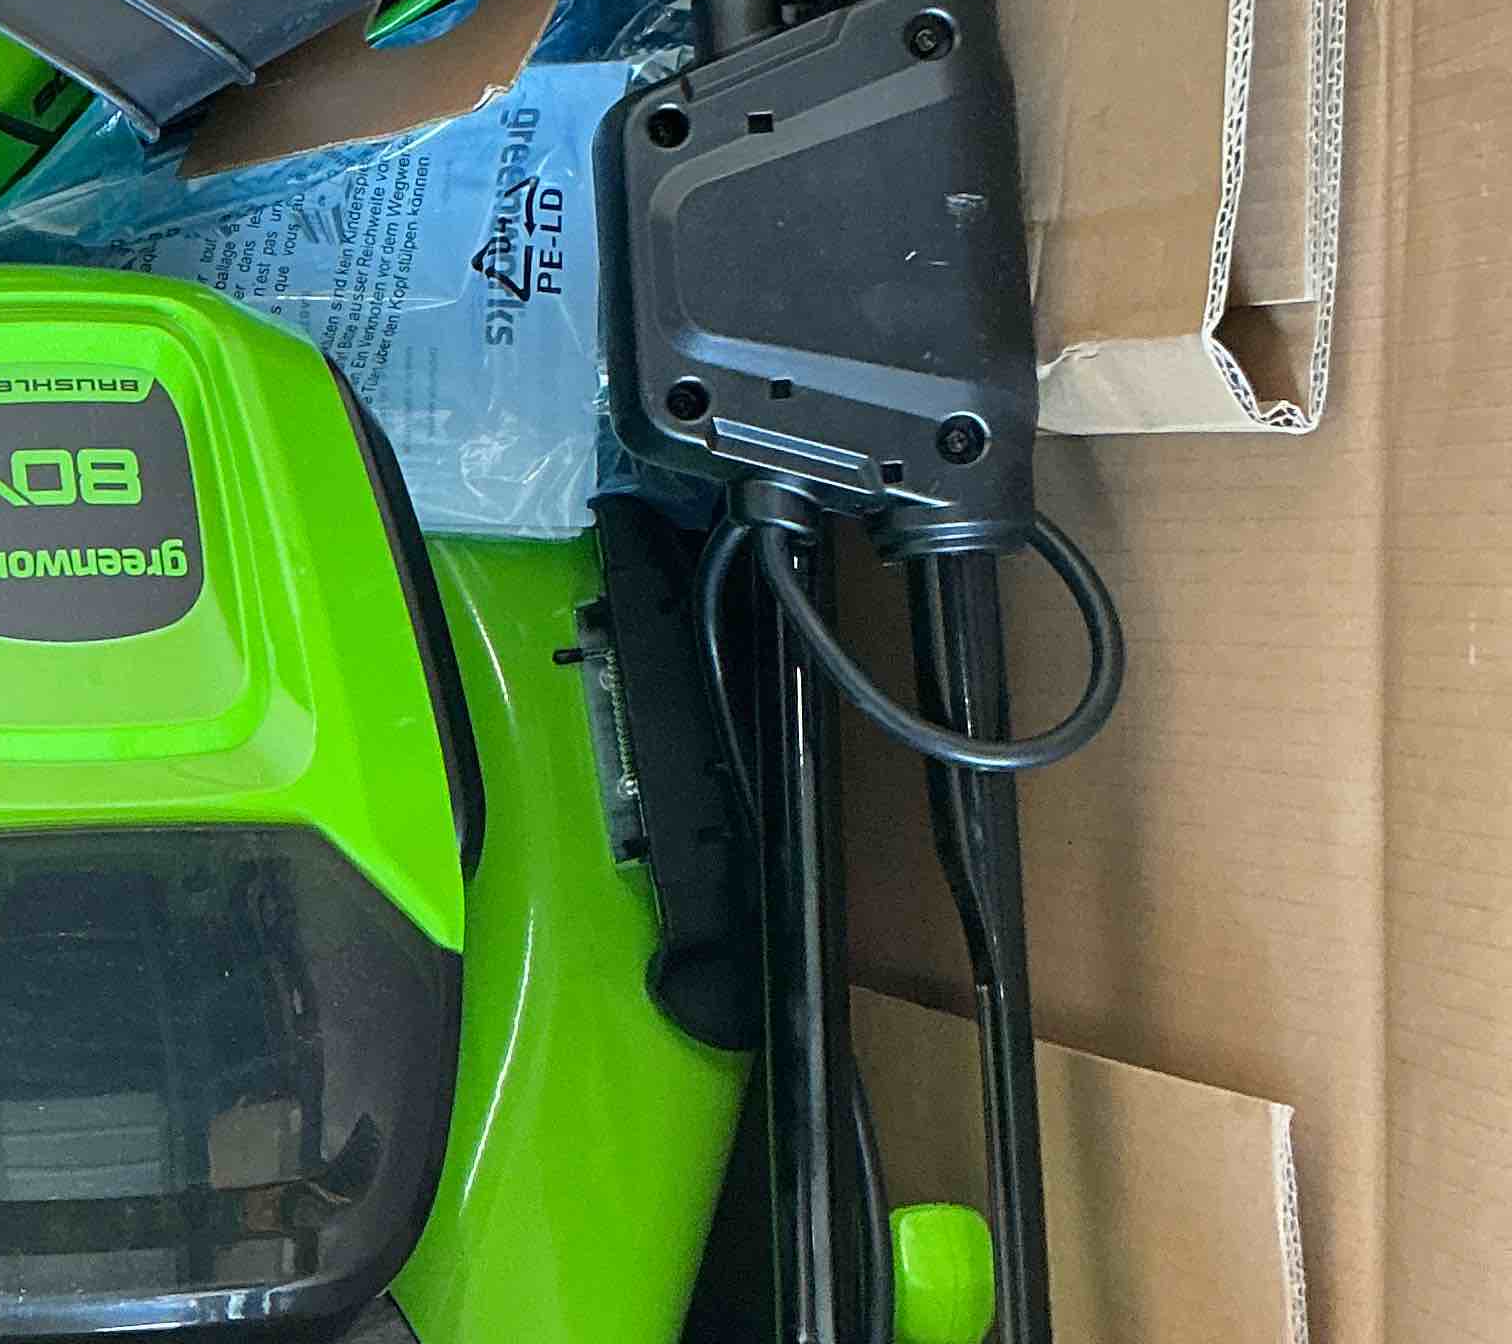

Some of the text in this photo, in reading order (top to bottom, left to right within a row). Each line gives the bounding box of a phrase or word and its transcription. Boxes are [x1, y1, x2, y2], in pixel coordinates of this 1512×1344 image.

[262, 231, 278, 257] pas
[356, 187, 386, 269] Reichweite
[383, 222, 400, 255] dem
[536, 188, 565, 295] PE-LD
[214, 241, 238, 290] ballage
[239, 240, 256, 273] dans
[378, 256, 391, 277] vor
[275, 266, 290, 293] que
[331, 278, 348, 311] sind
[349, 269, 368, 321] ausser
[389, 274, 409, 310] Kopf
[359, 281, 386, 348] Verknoten
